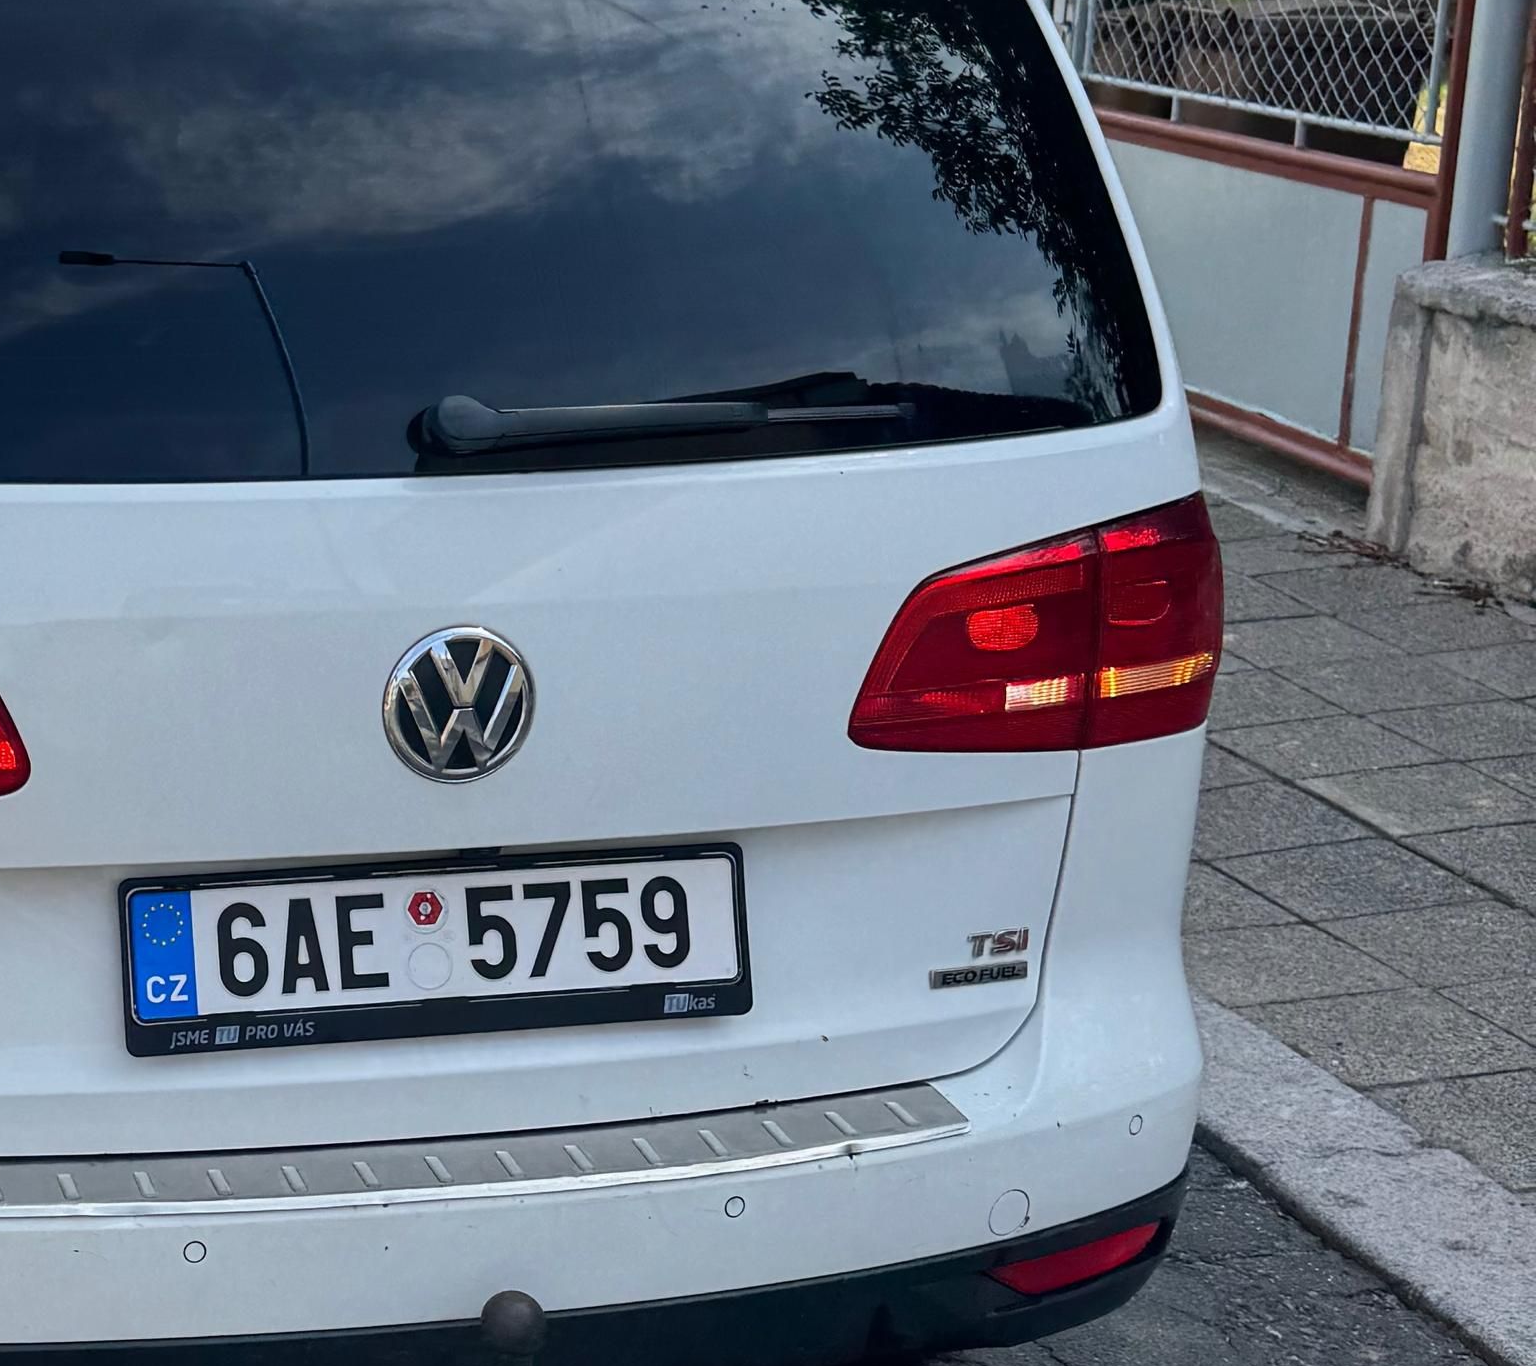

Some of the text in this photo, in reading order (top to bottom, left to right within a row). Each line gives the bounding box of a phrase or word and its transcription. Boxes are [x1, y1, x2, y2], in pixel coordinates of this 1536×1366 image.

[217, 875, 691, 998] 6AE 5759
[967, 927, 1030, 959] TSI
[146, 974, 189, 1004] CZ
[170, 1029, 209, 1049] JSME
[245, 1024, 278, 1041] PRO
[283, 1019, 315, 1037] VÁS
